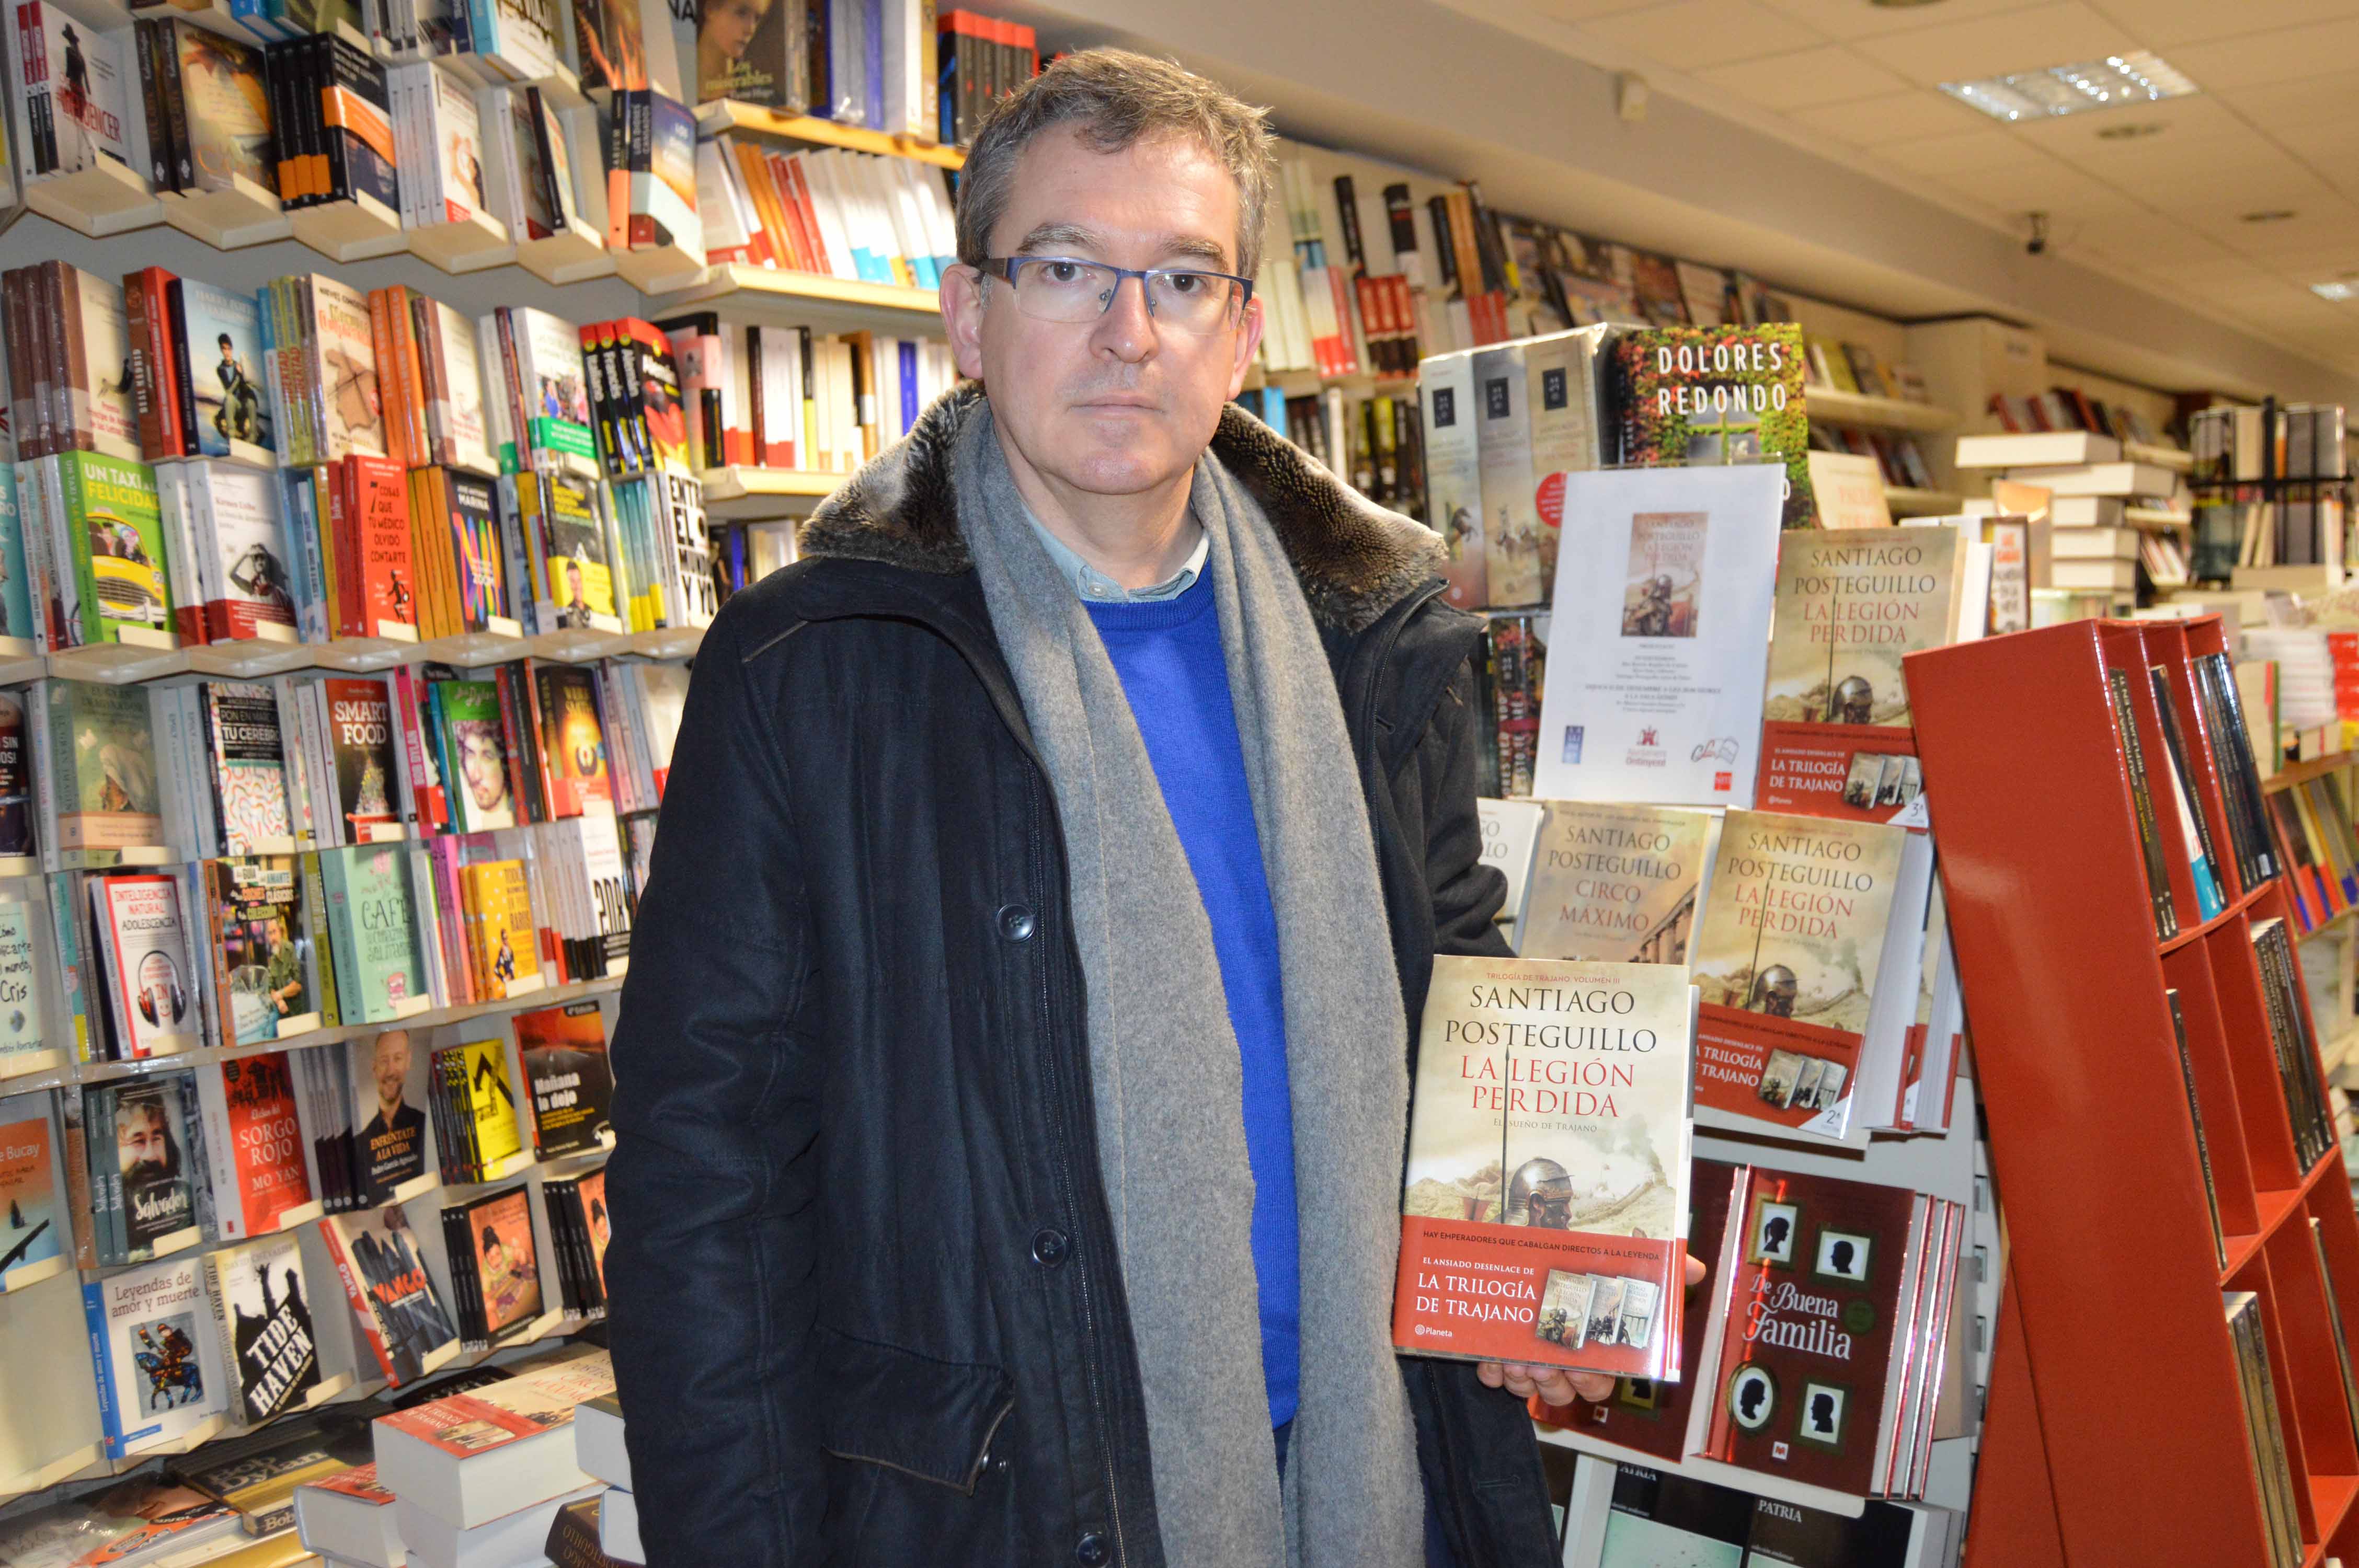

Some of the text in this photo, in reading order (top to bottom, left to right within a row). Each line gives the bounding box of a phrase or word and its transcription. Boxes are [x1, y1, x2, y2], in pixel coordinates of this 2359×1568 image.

[1658, 342, 1782, 374] DOLORES
[1658, 384, 1787, 416] REDONDO
[84, 463, 108, 481] UN
[109, 468, 142, 489] TAXI
[380, 486, 400, 498] COSAS
[379, 502, 393, 514] QUE
[368, 516, 377, 527] TU
[371, 549, 407, 564] CONTARTE
[1811, 546, 1922, 568] SANTIAGO
[1794, 574, 1936, 595] POSTEGUILLO
[1804, 599, 1919, 621] LA LEGIÓN
[1811, 625, 1907, 644] PERDIDA
[334, 701, 387, 722] SMART
[3, 736, 18, 749] SIN
[222, 726, 238, 740] TU
[342, 723, 387, 745] FOOD
[1772, 759, 1846, 776] LA TRILOGÍA
[1769, 776, 1844, 793] DE TRAJANO
[1567, 825, 1670, 852] SANTIAGO
[1748, 833, 1861, 861] SANTIAGO
[1549, 849, 1681, 880] POSTEGUILLO
[1728, 857, 1873, 892] POSTEGUILLO
[114, 889, 173, 903] INTELIGENCIA
[1576, 879, 1641, 904] CIRCO
[1735, 883, 1854, 918] LA LEGIÓN
[129, 903, 166, 915] NATURAL
[1560, 904, 1650, 932] MÁXIMO
[121, 916, 177, 931] ADOLESCENCIA
[1739, 907, 1838, 940] PERDIDA
[1487, 972, 1520, 981] TRILOGÍA
[0, 979, 27, 1003] Cris
[1470, 985, 1634, 1014] SANTIAGO
[1444, 1020, 1657, 1053] POSTEGUILLO
[1461, 1055, 1635, 1088] LA LEGIÓN
[1703, 1048, 1762, 1070] TRILOGÍA
[1702, 1064, 1759, 1087] TRAJANO
[1472, 1086, 1619, 1117] PERDIDA
[239, 1117, 296, 1149] SORGO
[6, 1144, 40, 1160] Bucay
[251, 1138, 293, 1166] ROJO
[252, 1166, 299, 1191] MO YAN
[134, 1187, 188, 1221] Salvador
[1423, 1230, 1438, 1239] HAY
[1440, 1232, 1497, 1244] EMPERADORES
[1498, 1237, 1516, 1247] QUE
[1517, 1239, 1561, 1251] CABALGAN
[1562, 1244, 1601, 1255] DIRECTOS
[1623, 1250, 1660, 1261] LEYENDA
[1433, 1258, 1472, 1269] ANSIADO
[1474, 1261, 1520, 1275] DESENLACE
[1523, 1267, 1535, 1275] DE
[115, 1271, 192, 1305] Leyendas de
[208, 1263, 226, 1321] TIDE HAVEN
[339, 1263, 358, 1299] VANGO
[372, 1267, 427, 1305] VANGO
[1417, 1273, 1536, 1300] LA TRILOGÍA
[1749, 1274, 1772, 1294] De
[111, 1286, 200, 1318] amor y muerte
[1416, 1297, 1533, 1323] DE TRAJANO
[1770, 1282, 1838, 1318] Buena
[246, 1304, 298, 1369] TIDE
[1425, 1327, 1452, 1338] Planeta
[1742, 1301, 1851, 1361] Familia
[249, 1325, 313, 1416] HAVEN
[264, 1512, 296, 1531] Bob
[1757, 1499, 1802, 1523] PATRIA
